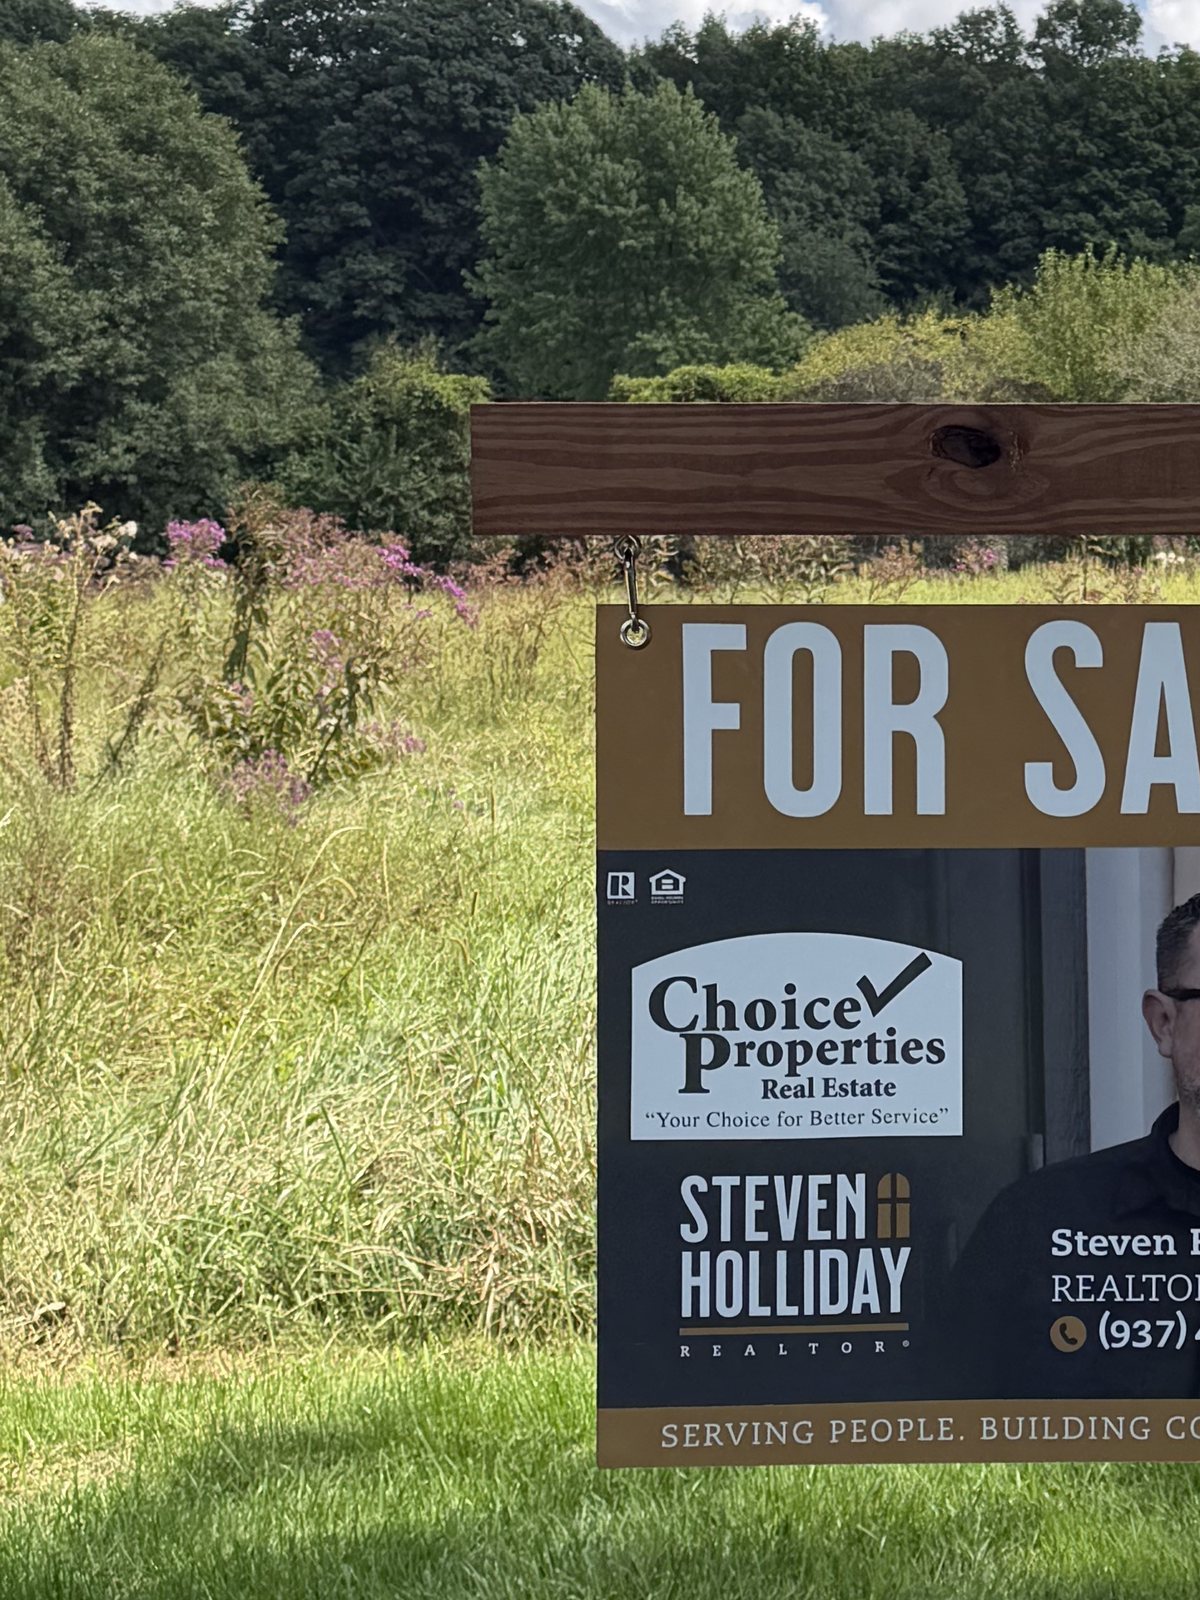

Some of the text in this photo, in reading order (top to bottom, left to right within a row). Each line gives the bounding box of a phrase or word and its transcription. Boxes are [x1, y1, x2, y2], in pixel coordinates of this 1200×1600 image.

[682, 622, 949, 818] FOR
[649, 976, 861, 1032] Choice
[678, 1026, 946, 1094] Properties
[761, 1077, 897, 1100] Real Estate
[706, 1111, 770, 1128] Choice
[777, 1110, 803, 1127] for
[810, 1109, 865, 1126] Better
[680, 1173, 866, 1243] STEVEN
[1051, 1228, 1177, 1256] Steven
[681, 1247, 911, 1318] HOLLIDAY
[1099, 1310, 1187, 1350] (937)
[661, 1420, 814, 1448] SERVING
[829, 1417, 965, 1443] PEOPLE.
[980, 1416, 1151, 1441] BUILDING
